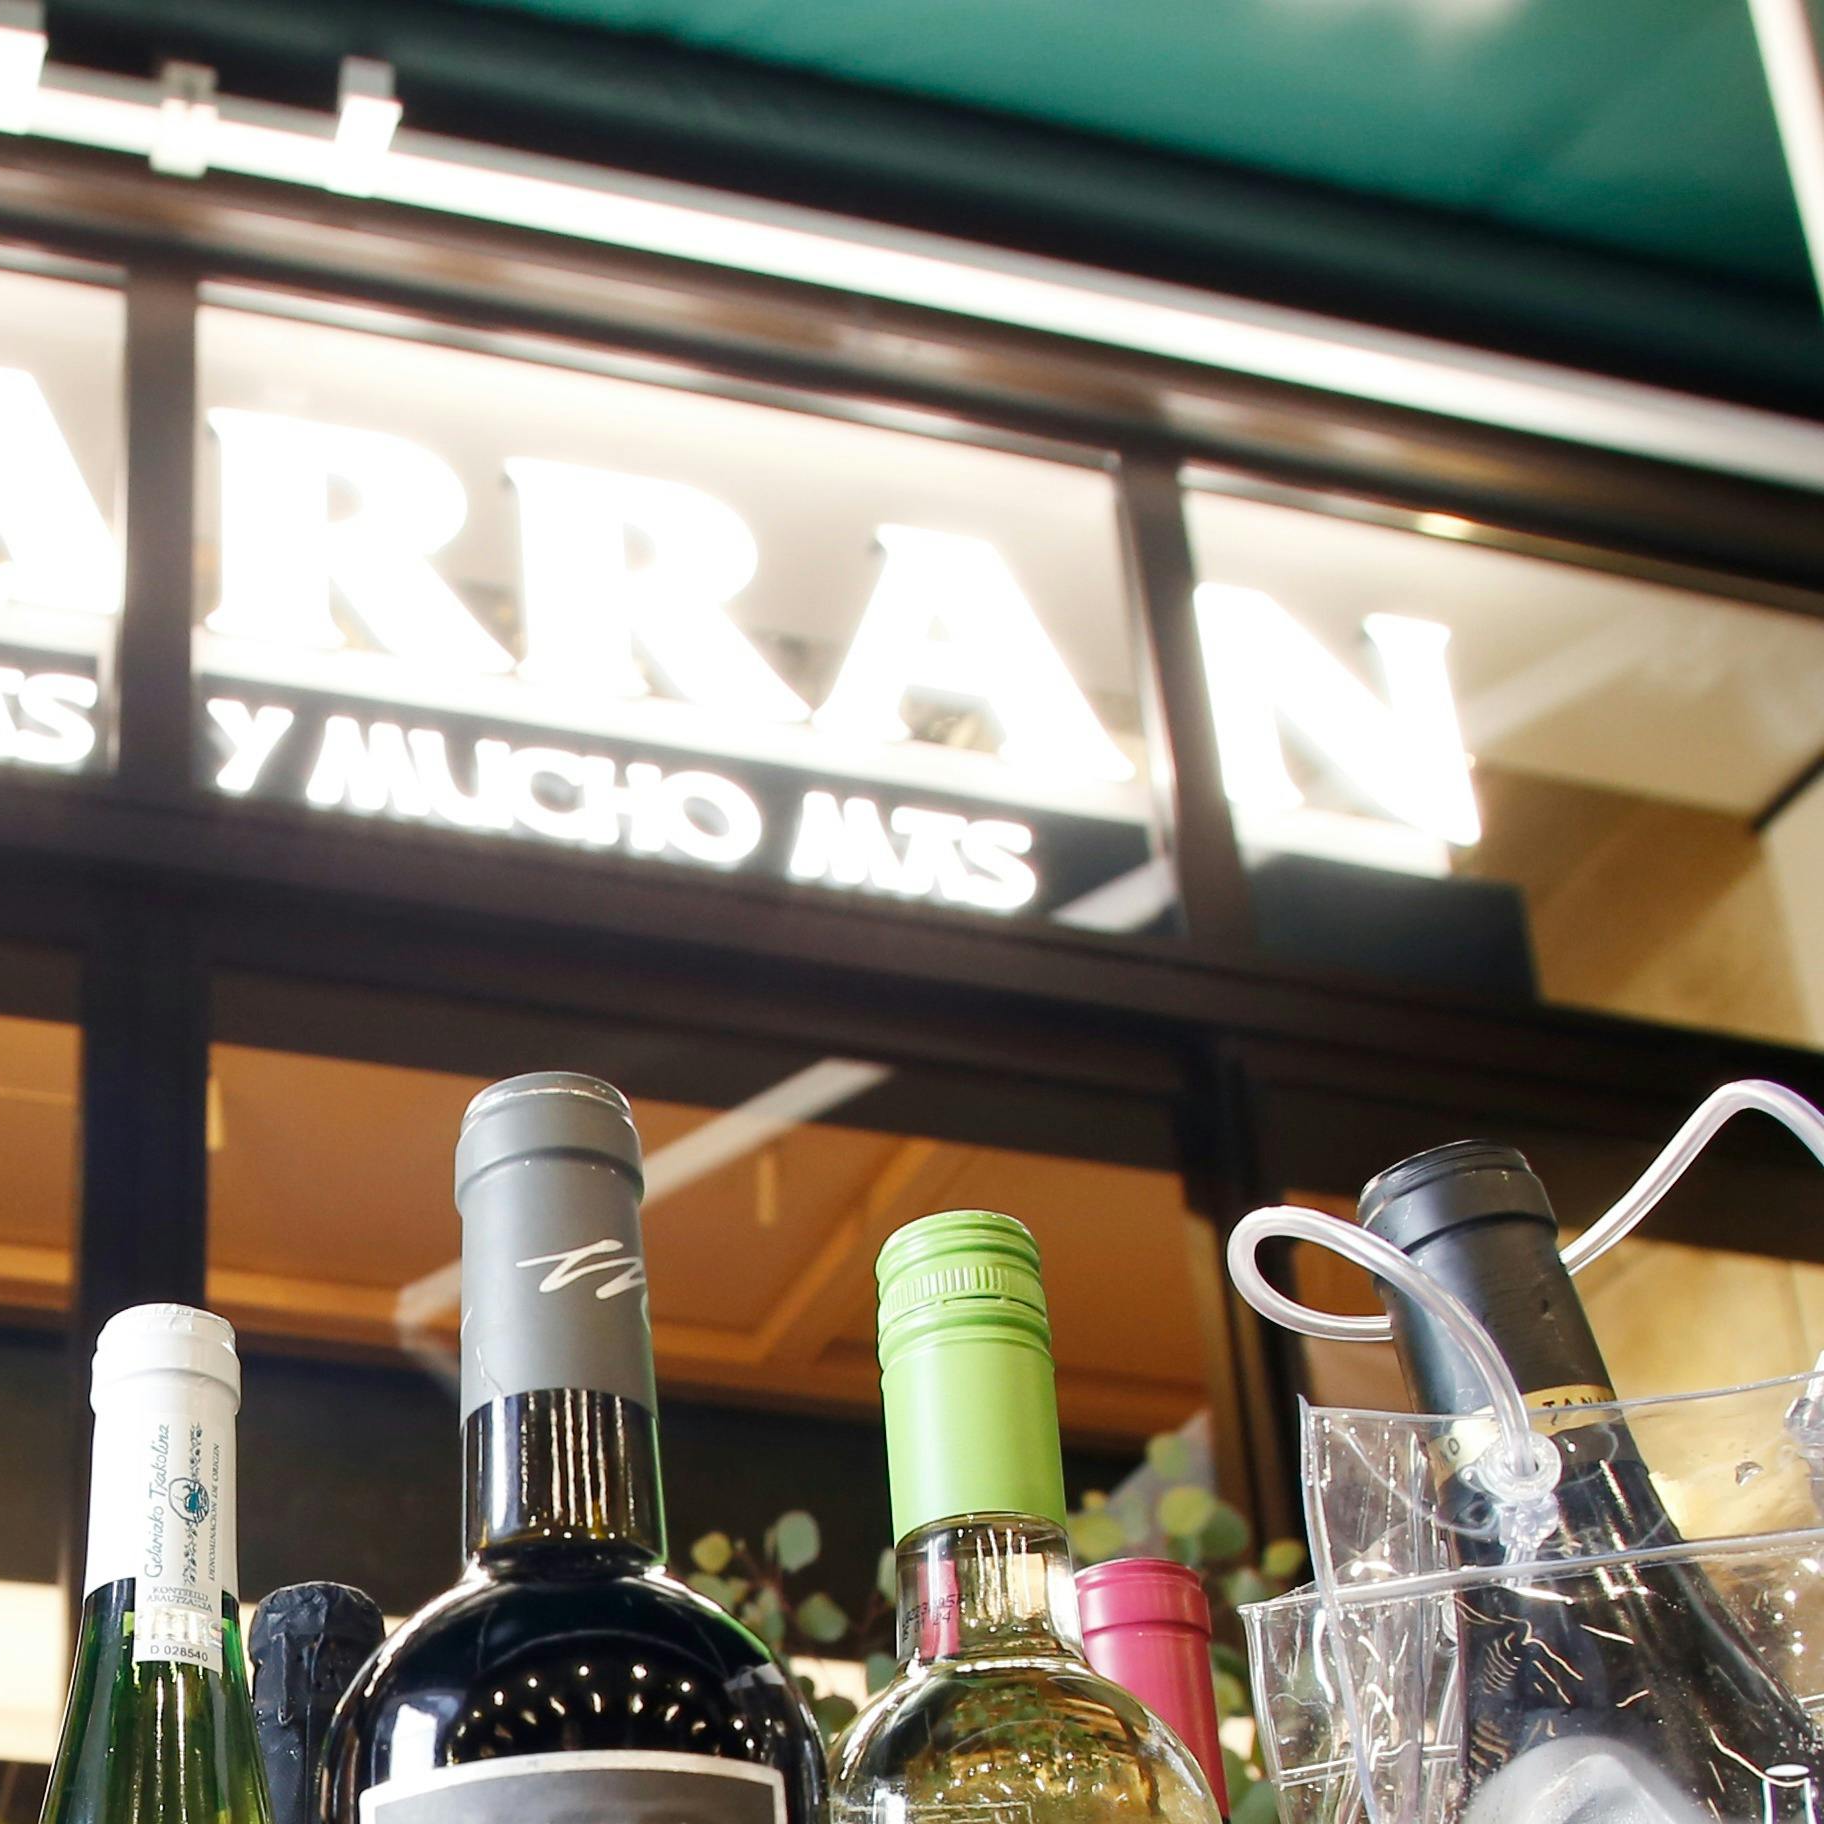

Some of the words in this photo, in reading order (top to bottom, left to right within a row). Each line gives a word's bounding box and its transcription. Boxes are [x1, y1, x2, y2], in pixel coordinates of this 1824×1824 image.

[205, 697, 294, 796] Y
[306, 712, 763, 867] MUCHO
[163, 1644, 209, 1662] 028540
